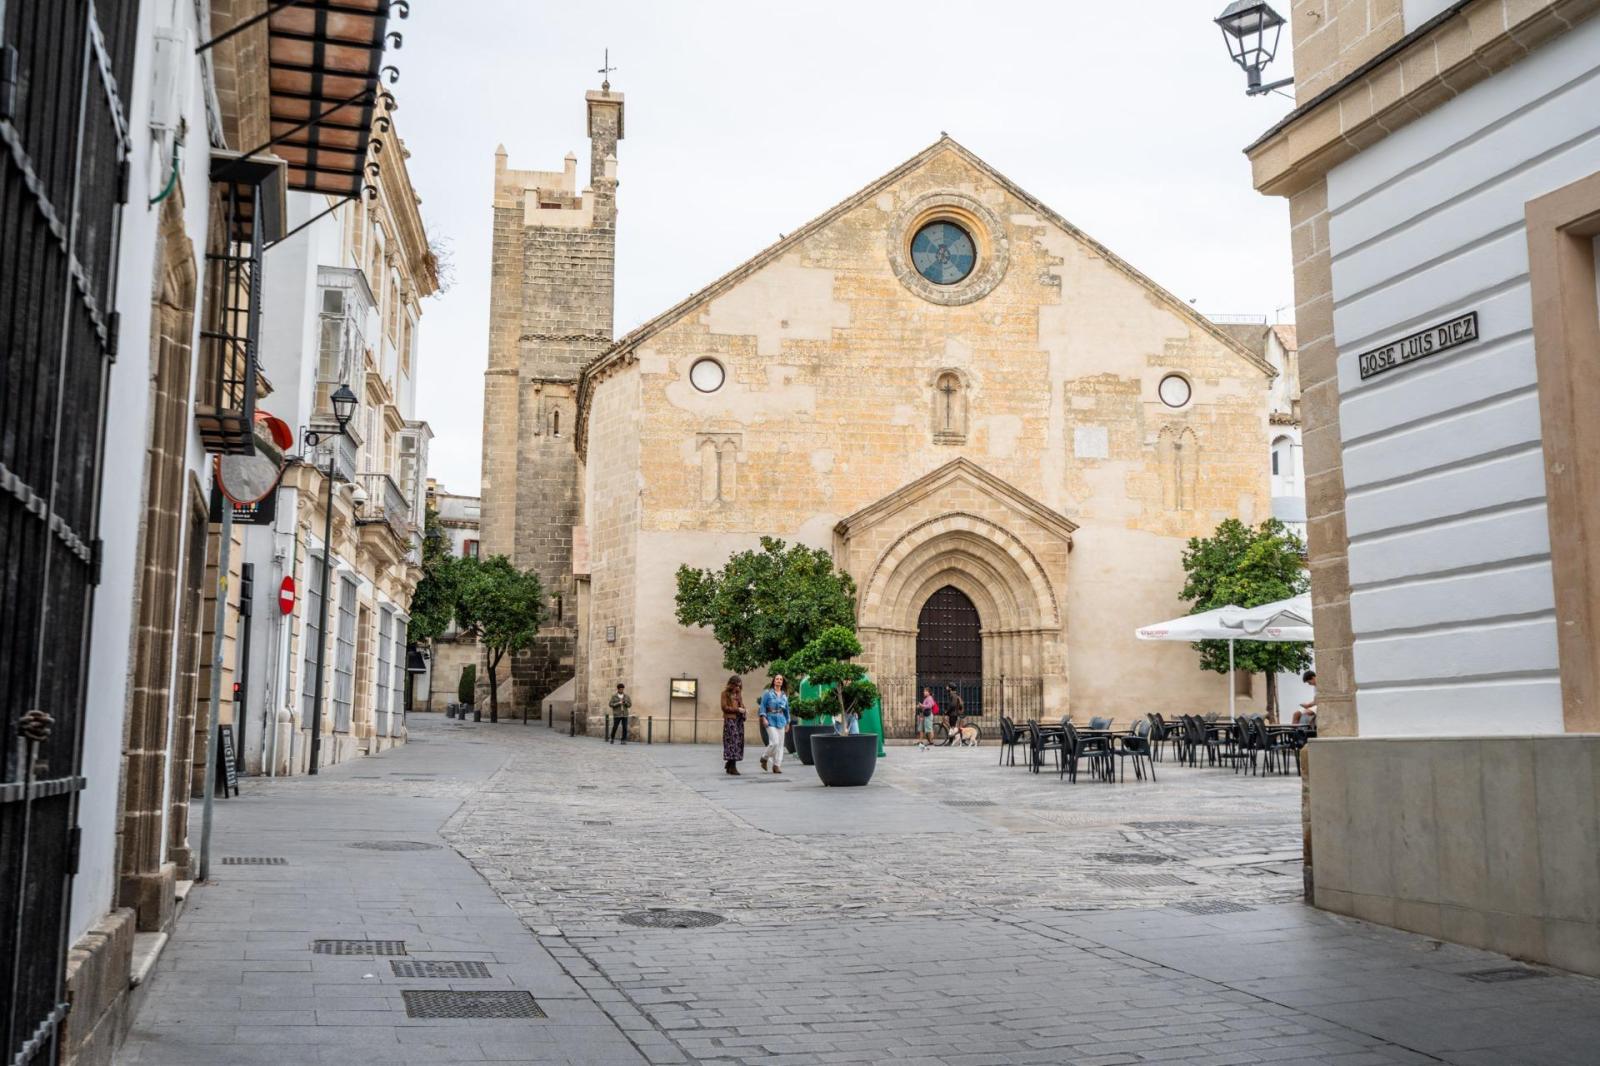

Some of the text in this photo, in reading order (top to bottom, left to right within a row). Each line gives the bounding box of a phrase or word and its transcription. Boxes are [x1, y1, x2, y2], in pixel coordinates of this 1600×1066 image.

[1362, 318, 1473, 374] JOSE LUIS DIEZ
